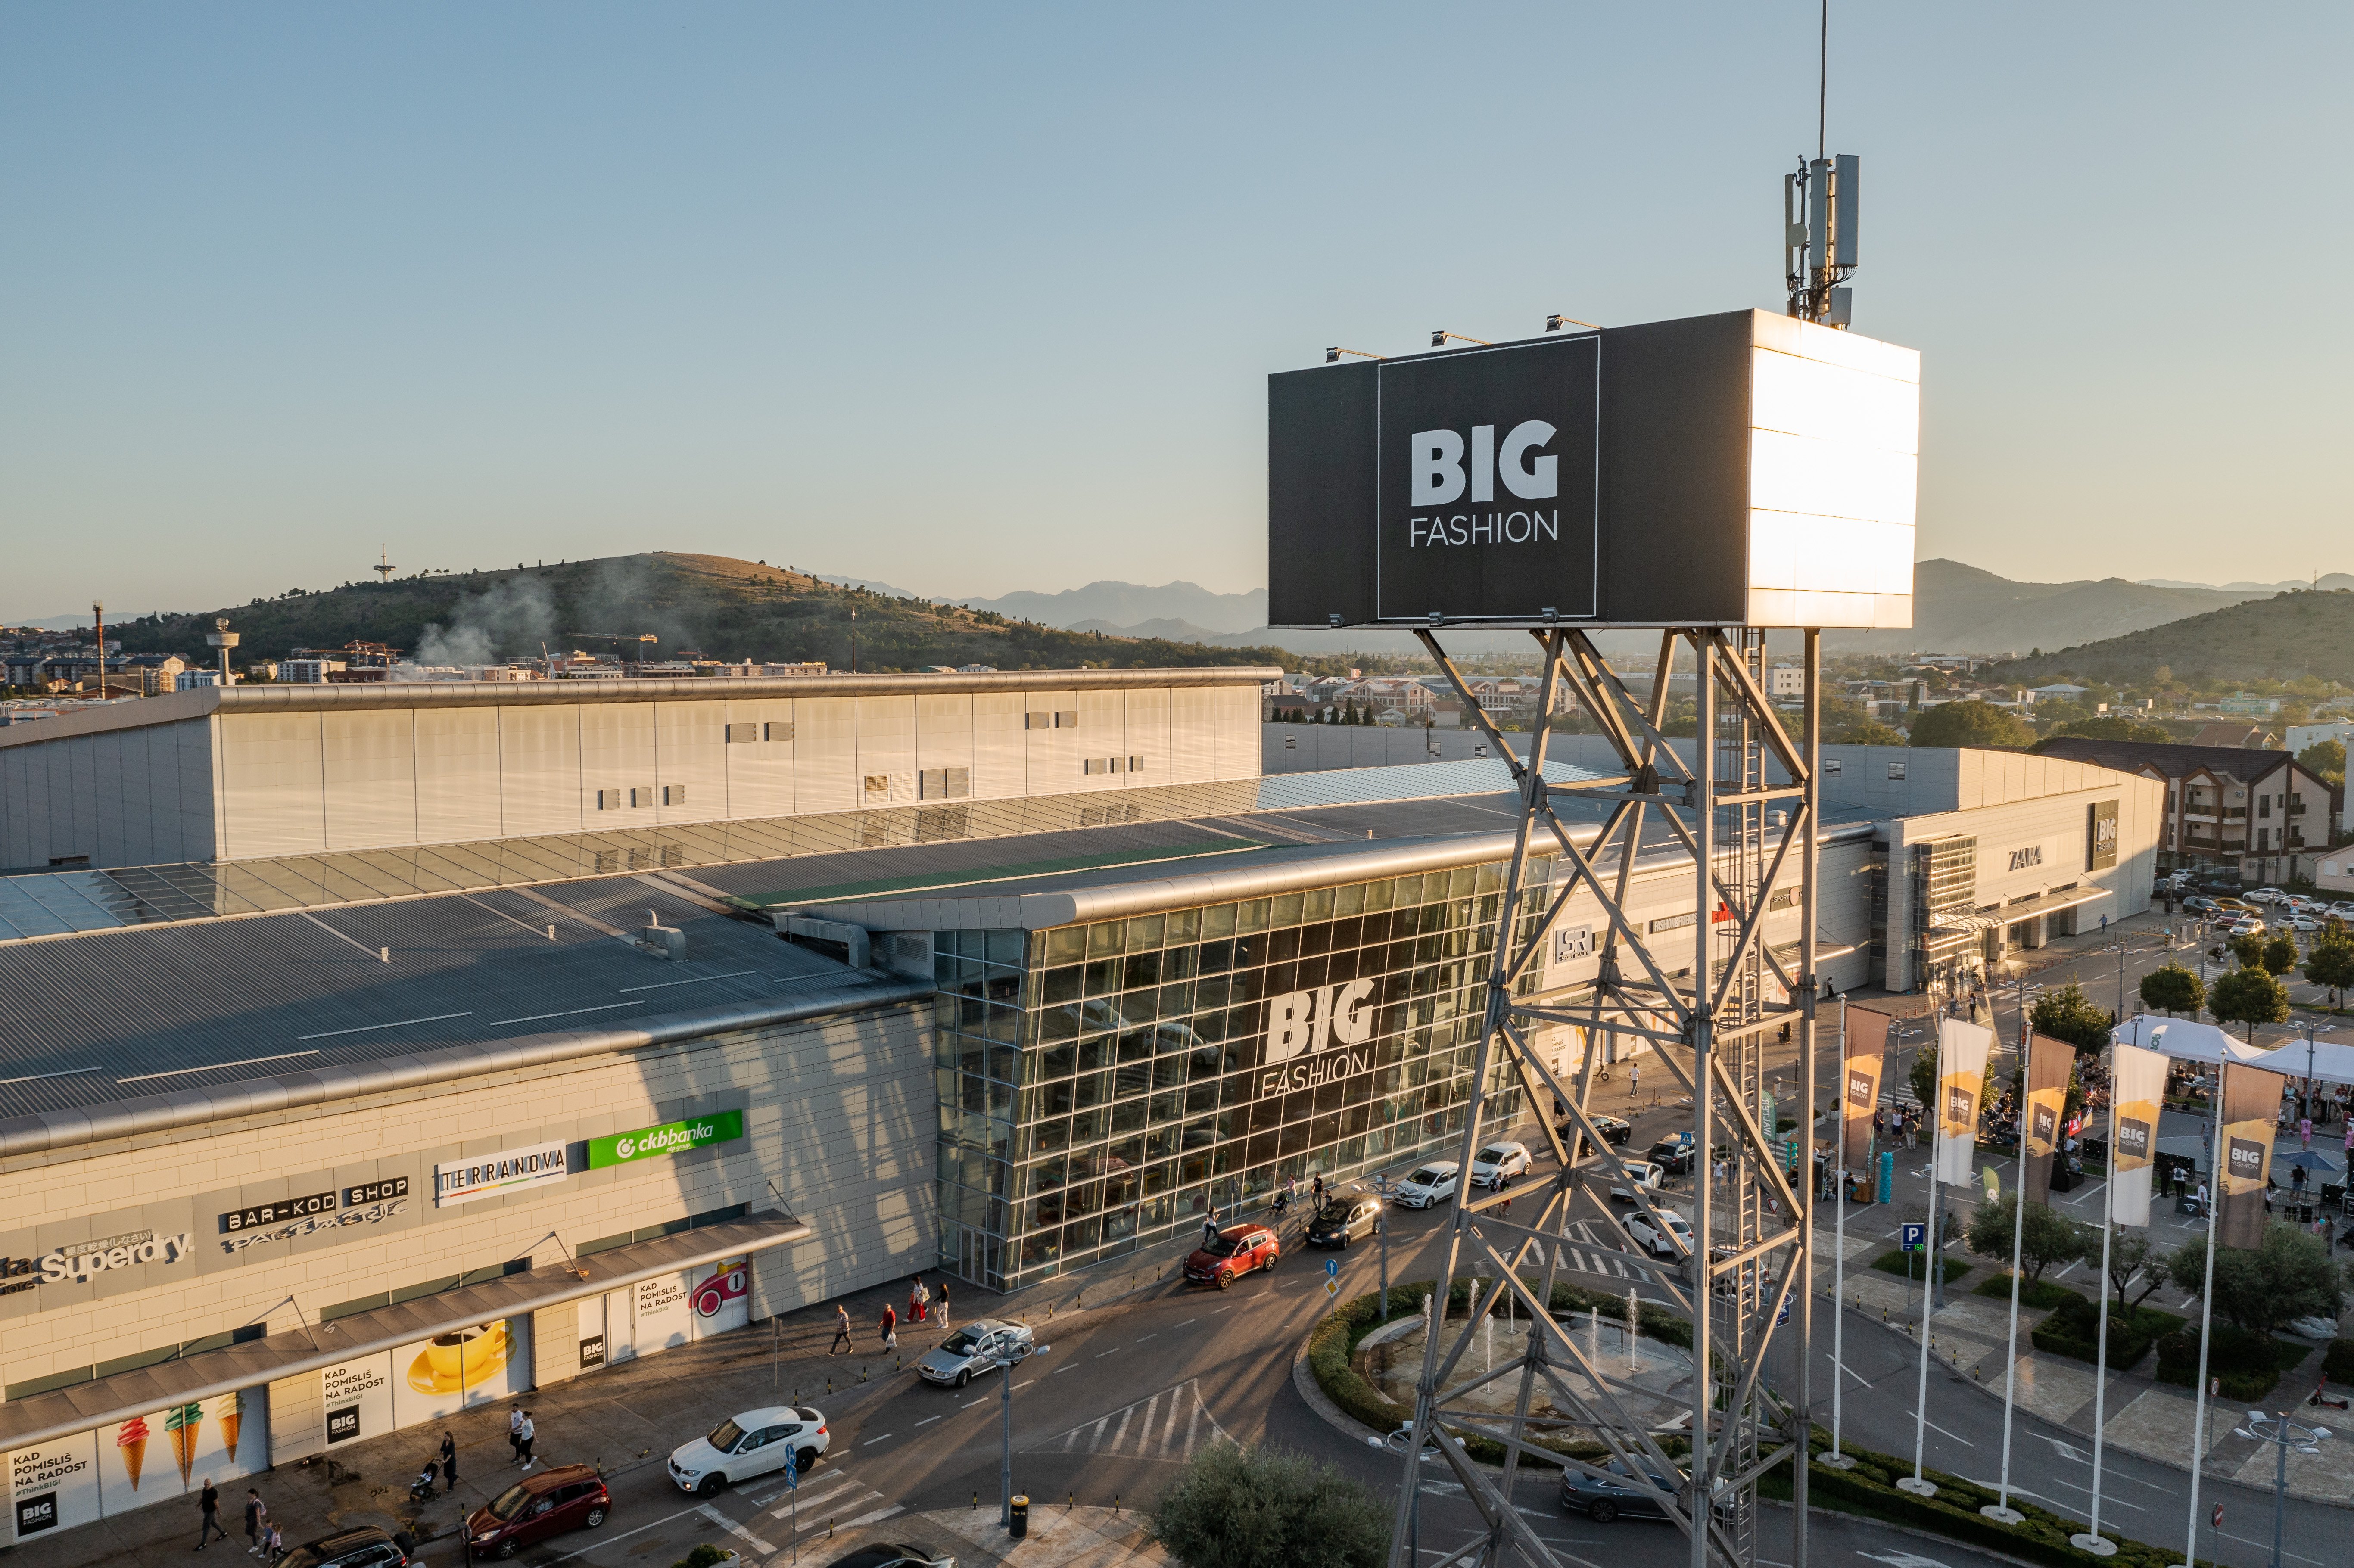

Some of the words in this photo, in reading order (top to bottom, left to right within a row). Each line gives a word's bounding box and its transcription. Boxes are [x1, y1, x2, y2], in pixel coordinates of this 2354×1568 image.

[1411, 420, 1558, 507] BIG
[1411, 510, 1557, 547] FASHION
[2099, 818, 2116, 841] BIG
[2009, 845, 2044, 871] ZARA
[1774, 894, 1790, 902] SPORT
[1563, 928, 1587, 955] SR
[1265, 977, 1375, 1064] BIG
[1261, 1049, 1369, 1099] FASHION
[1851, 1078, 1868, 1094] BIG
[1951, 1096, 1969, 1111] BIG
[638, 1123, 713, 1151] ckbbanka
[2120, 1126, 2145, 1143] BIG
[2120, 1138, 2144, 1148] FASHION
[676, 1143, 690, 1151] group
[2232, 1148, 2259, 1164] BIG
[443, 1149, 564, 1190] TERRANOVA
[2231, 1160, 2258, 1170] FASHION
[229, 1195, 335, 1229] BAR-KOD
[352, 1180, 406, 1203] SHOP
[1909, 1227, 1919, 1241] P
[65, 1230, 151, 1257] 極度乾燥(しなさい)
[640, 1283, 657, 1293] KAD
[734, 1273, 741, 1290] 1
[641, 1284, 677, 1302] POMISLIŠ
[641, 1302, 653, 1310] NA
[655, 1291, 687, 1306] RADOST
[641, 1305, 670, 1317] #ThinkBIG!
[583, 1341, 603, 1356] BIG
[584, 1351, 604, 1361] FASHION
[325, 1369, 346, 1380] KAD
[325, 1369, 372, 1390] POMISLIŠ
[326, 1391, 341, 1400] NA
[344, 1377, 385, 1395] RADOST
[326, 1393, 363, 1408] #ThinkBIG!
[332, 1414, 355, 1430] BIG
[332, 1424, 355, 1435] FASHION
[14, 1452, 40, 1465] KAD
[14, 1452, 72, 1477] POMISLIŠ
[15, 1477, 34, 1488] NA
[38, 1460, 88, 1481] RADOST
[16, 1479, 61, 1496] #ThinkBIG!
[23, 1503, 51, 1521] BIG
[23, 1514, 52, 1526] FASHION
